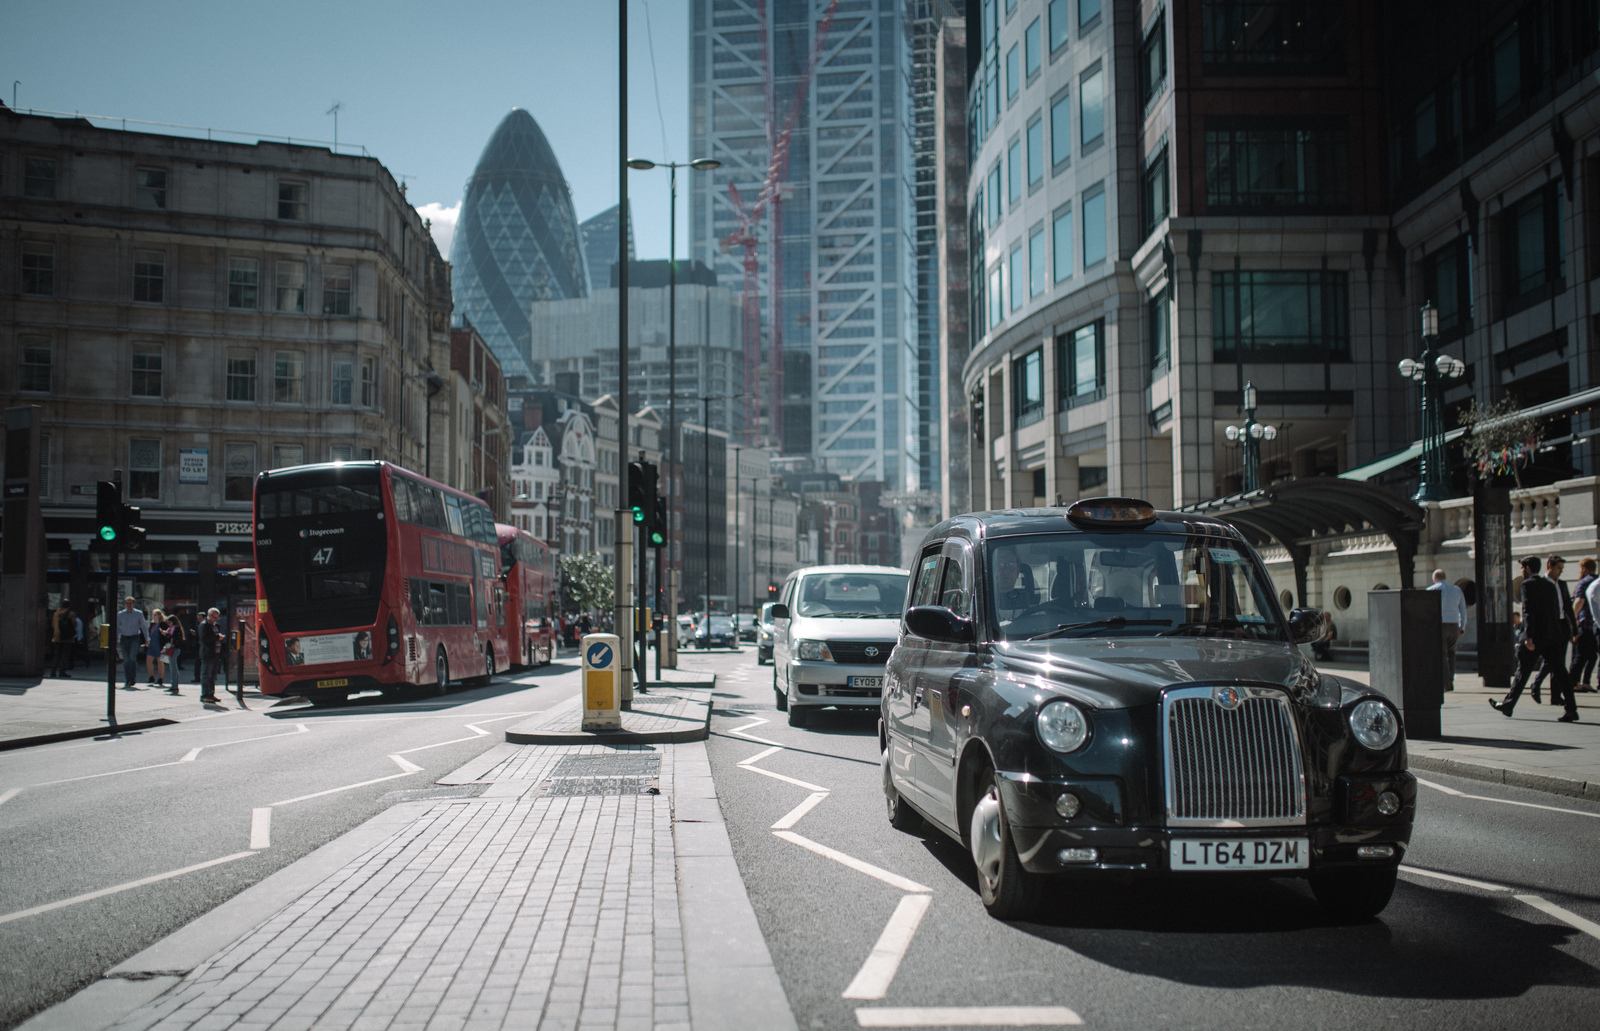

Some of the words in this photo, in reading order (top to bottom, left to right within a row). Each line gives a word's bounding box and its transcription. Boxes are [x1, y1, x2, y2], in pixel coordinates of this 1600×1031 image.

[313, 547, 334, 565] 47
[854, 677, 876, 687] EY09
[1182, 842, 1246, 865] LT64
[1253, 841, 1299, 865] DZM
